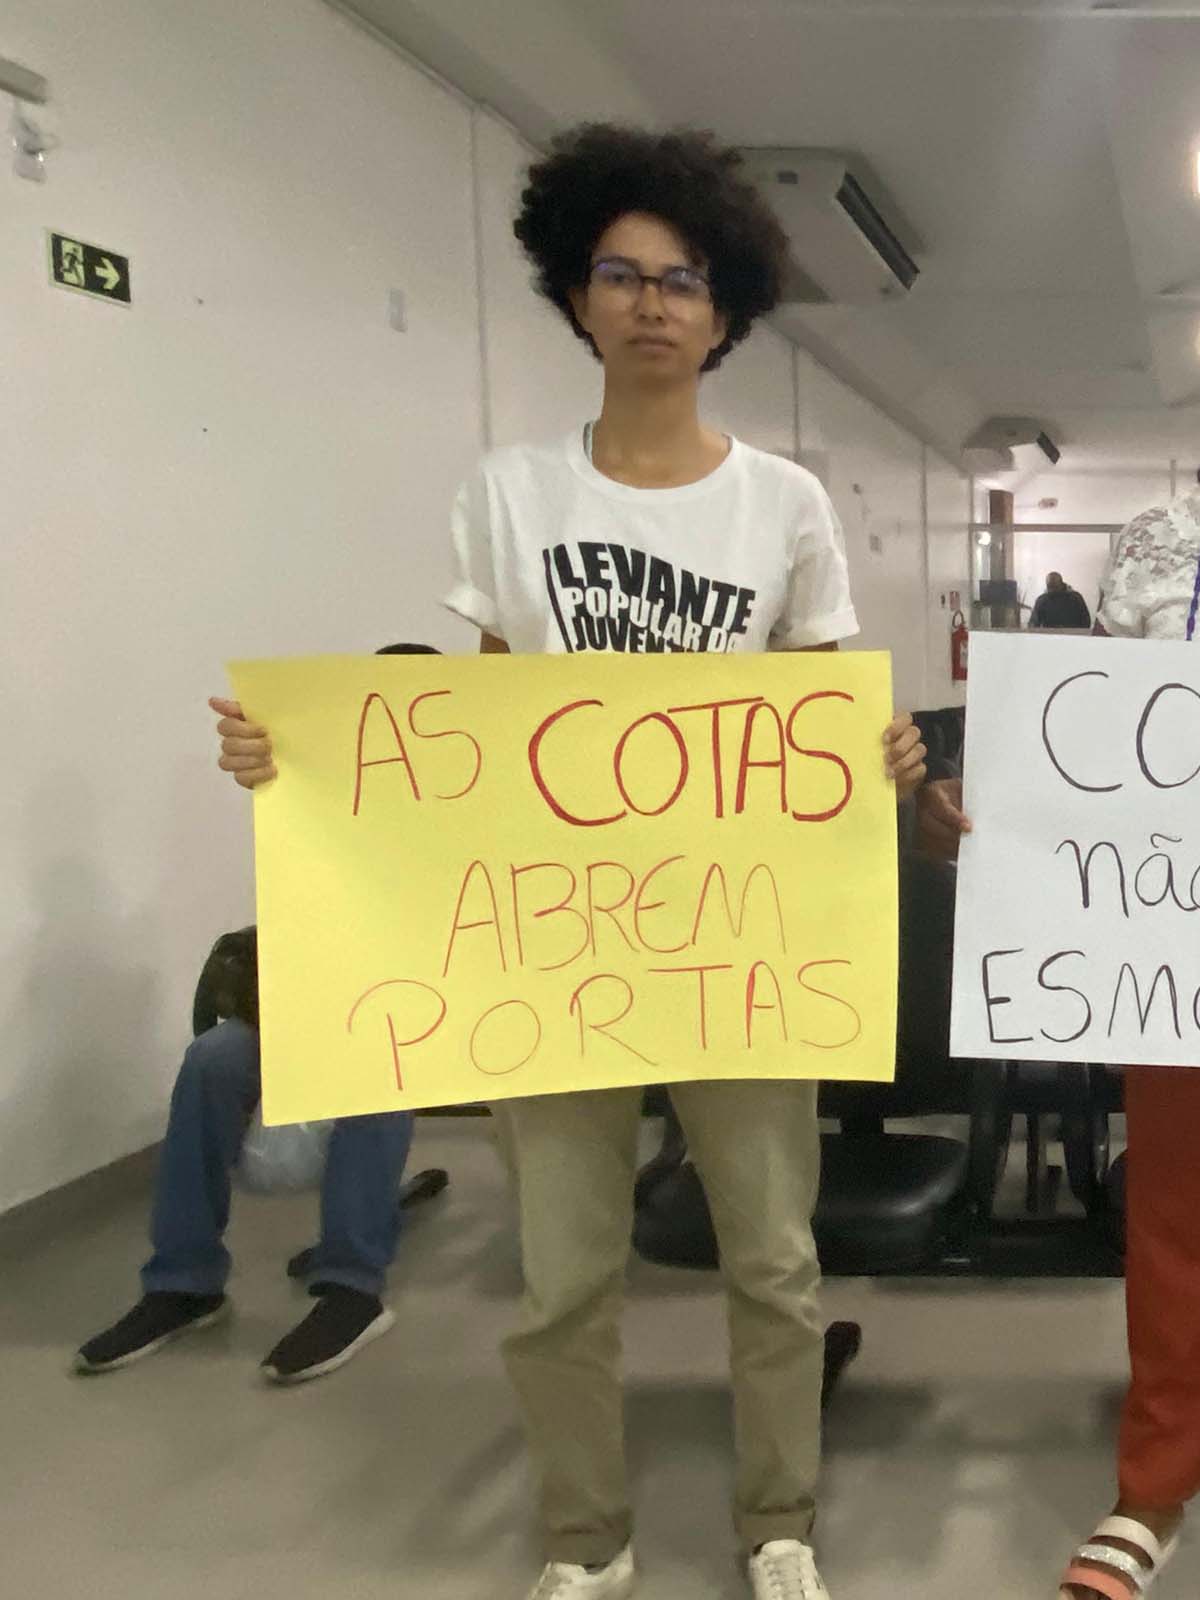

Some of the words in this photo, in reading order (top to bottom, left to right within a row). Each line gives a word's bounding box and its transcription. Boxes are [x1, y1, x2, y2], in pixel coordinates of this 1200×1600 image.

[554, 542, 756, 635] LEVANTE
[561, 586, 703, 652] POPULAR
[572, 616, 706, 653] JUVEN
[353, 690, 482, 816] AS
[528, 690, 854, 827] COTAS
[442, 855, 787, 978] ABREM
[347, 960, 861, 1091] PORTAS
